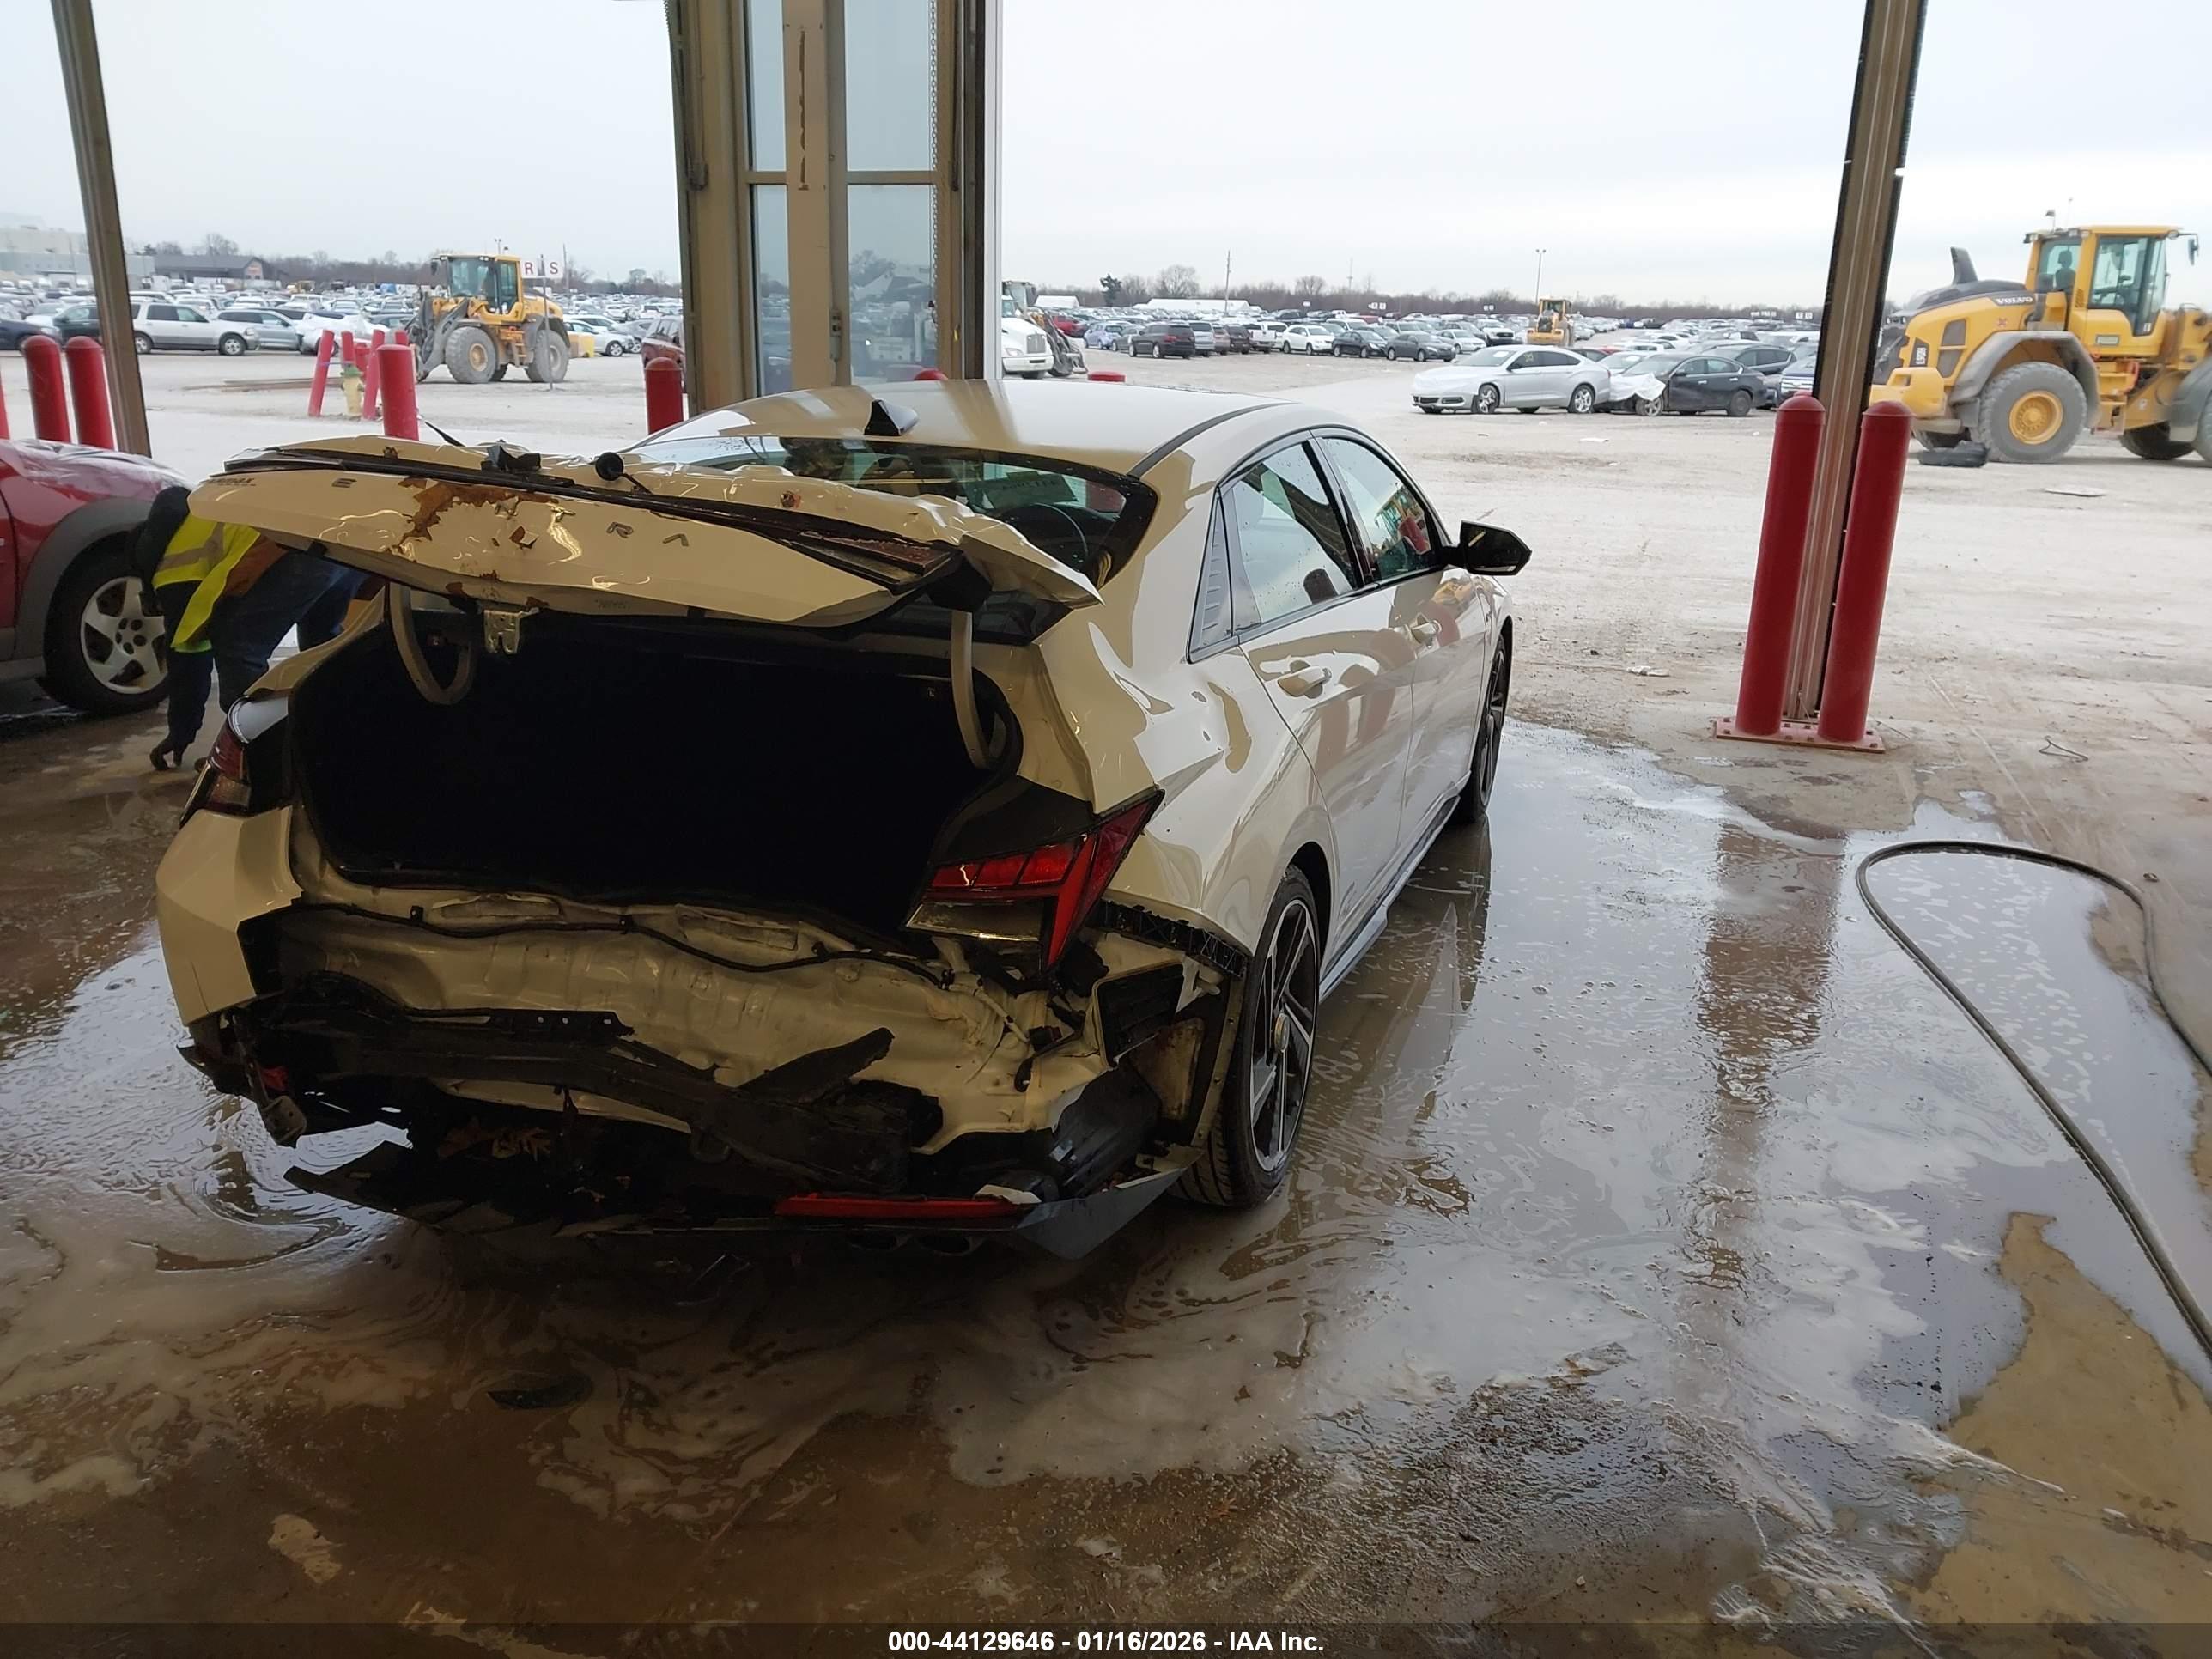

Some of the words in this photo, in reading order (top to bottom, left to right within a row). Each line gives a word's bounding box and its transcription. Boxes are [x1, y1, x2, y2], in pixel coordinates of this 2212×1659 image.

[525, 261, 534, 276] R
[550, 261, 558, 275] S
[1995, 296, 2033, 305] VOLVO
